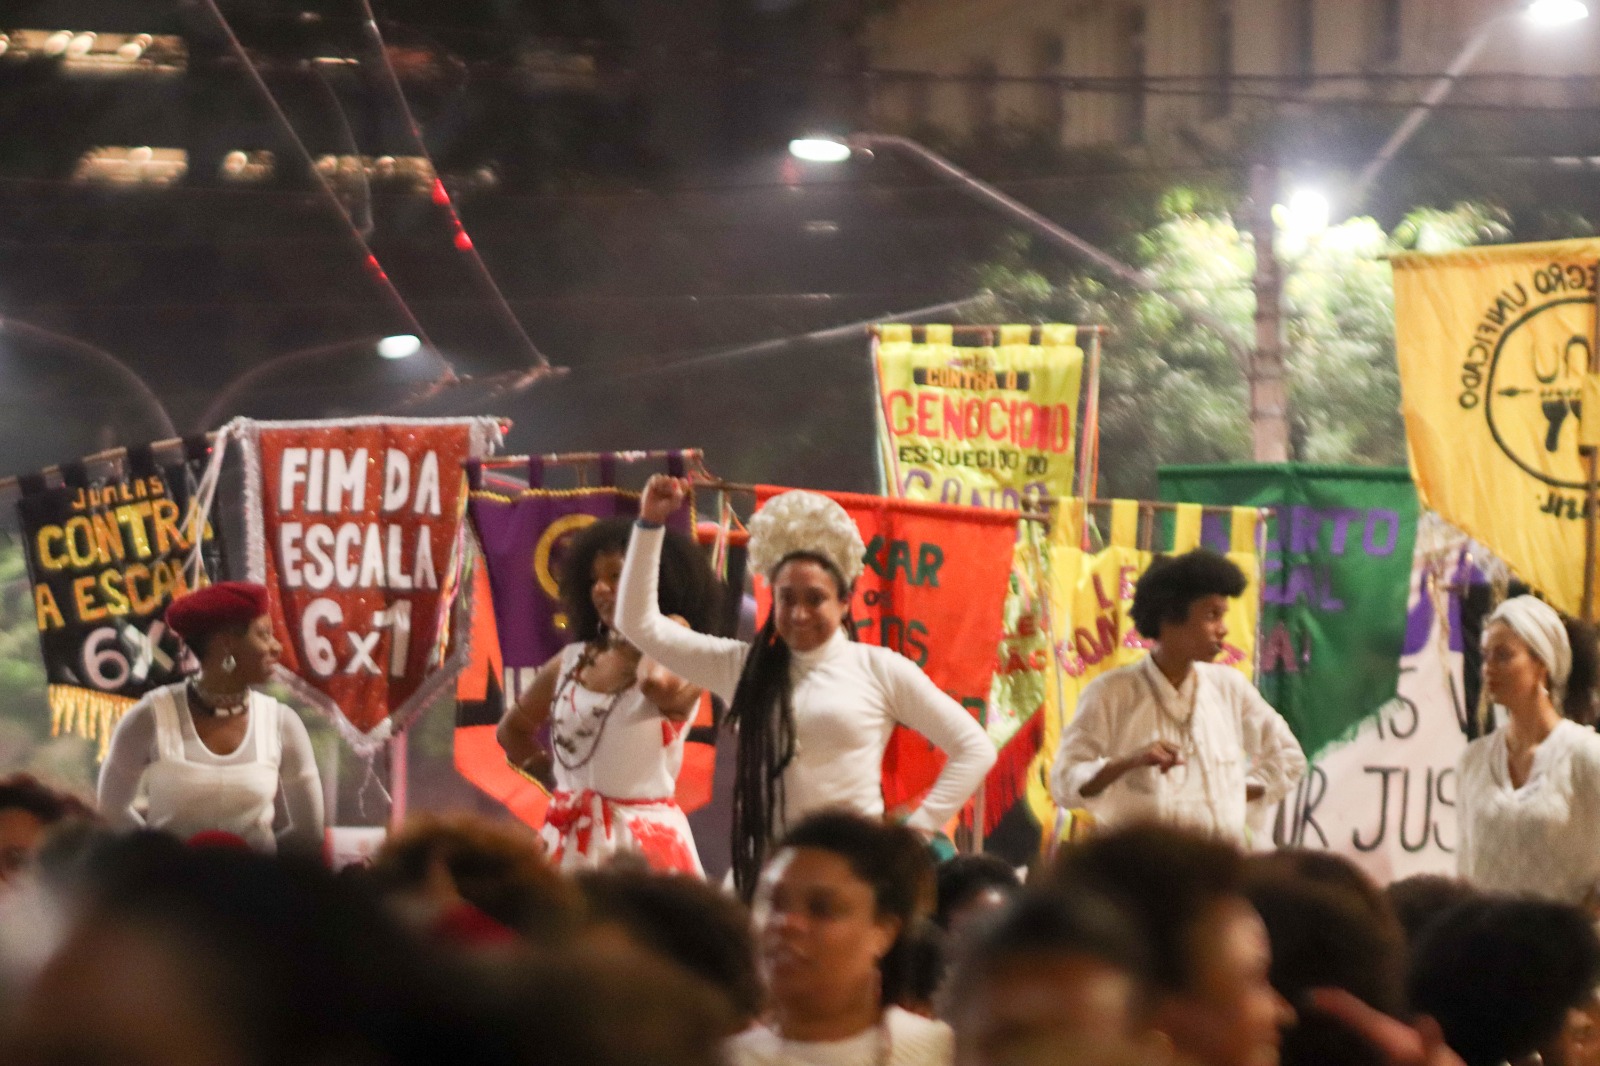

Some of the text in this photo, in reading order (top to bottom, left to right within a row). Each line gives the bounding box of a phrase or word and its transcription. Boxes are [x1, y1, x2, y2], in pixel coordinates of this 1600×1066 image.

[925, 367, 998, 391] CONTRA
[280, 447, 441, 515] FIM DA
[899, 445, 1019, 471] ESQUECIDO
[37, 495, 214, 569] CONTRA
[281, 522, 438, 590] ESCALA
[35, 558, 211, 631] A ESCAL
[1353, 765, 1456, 853] JUS
